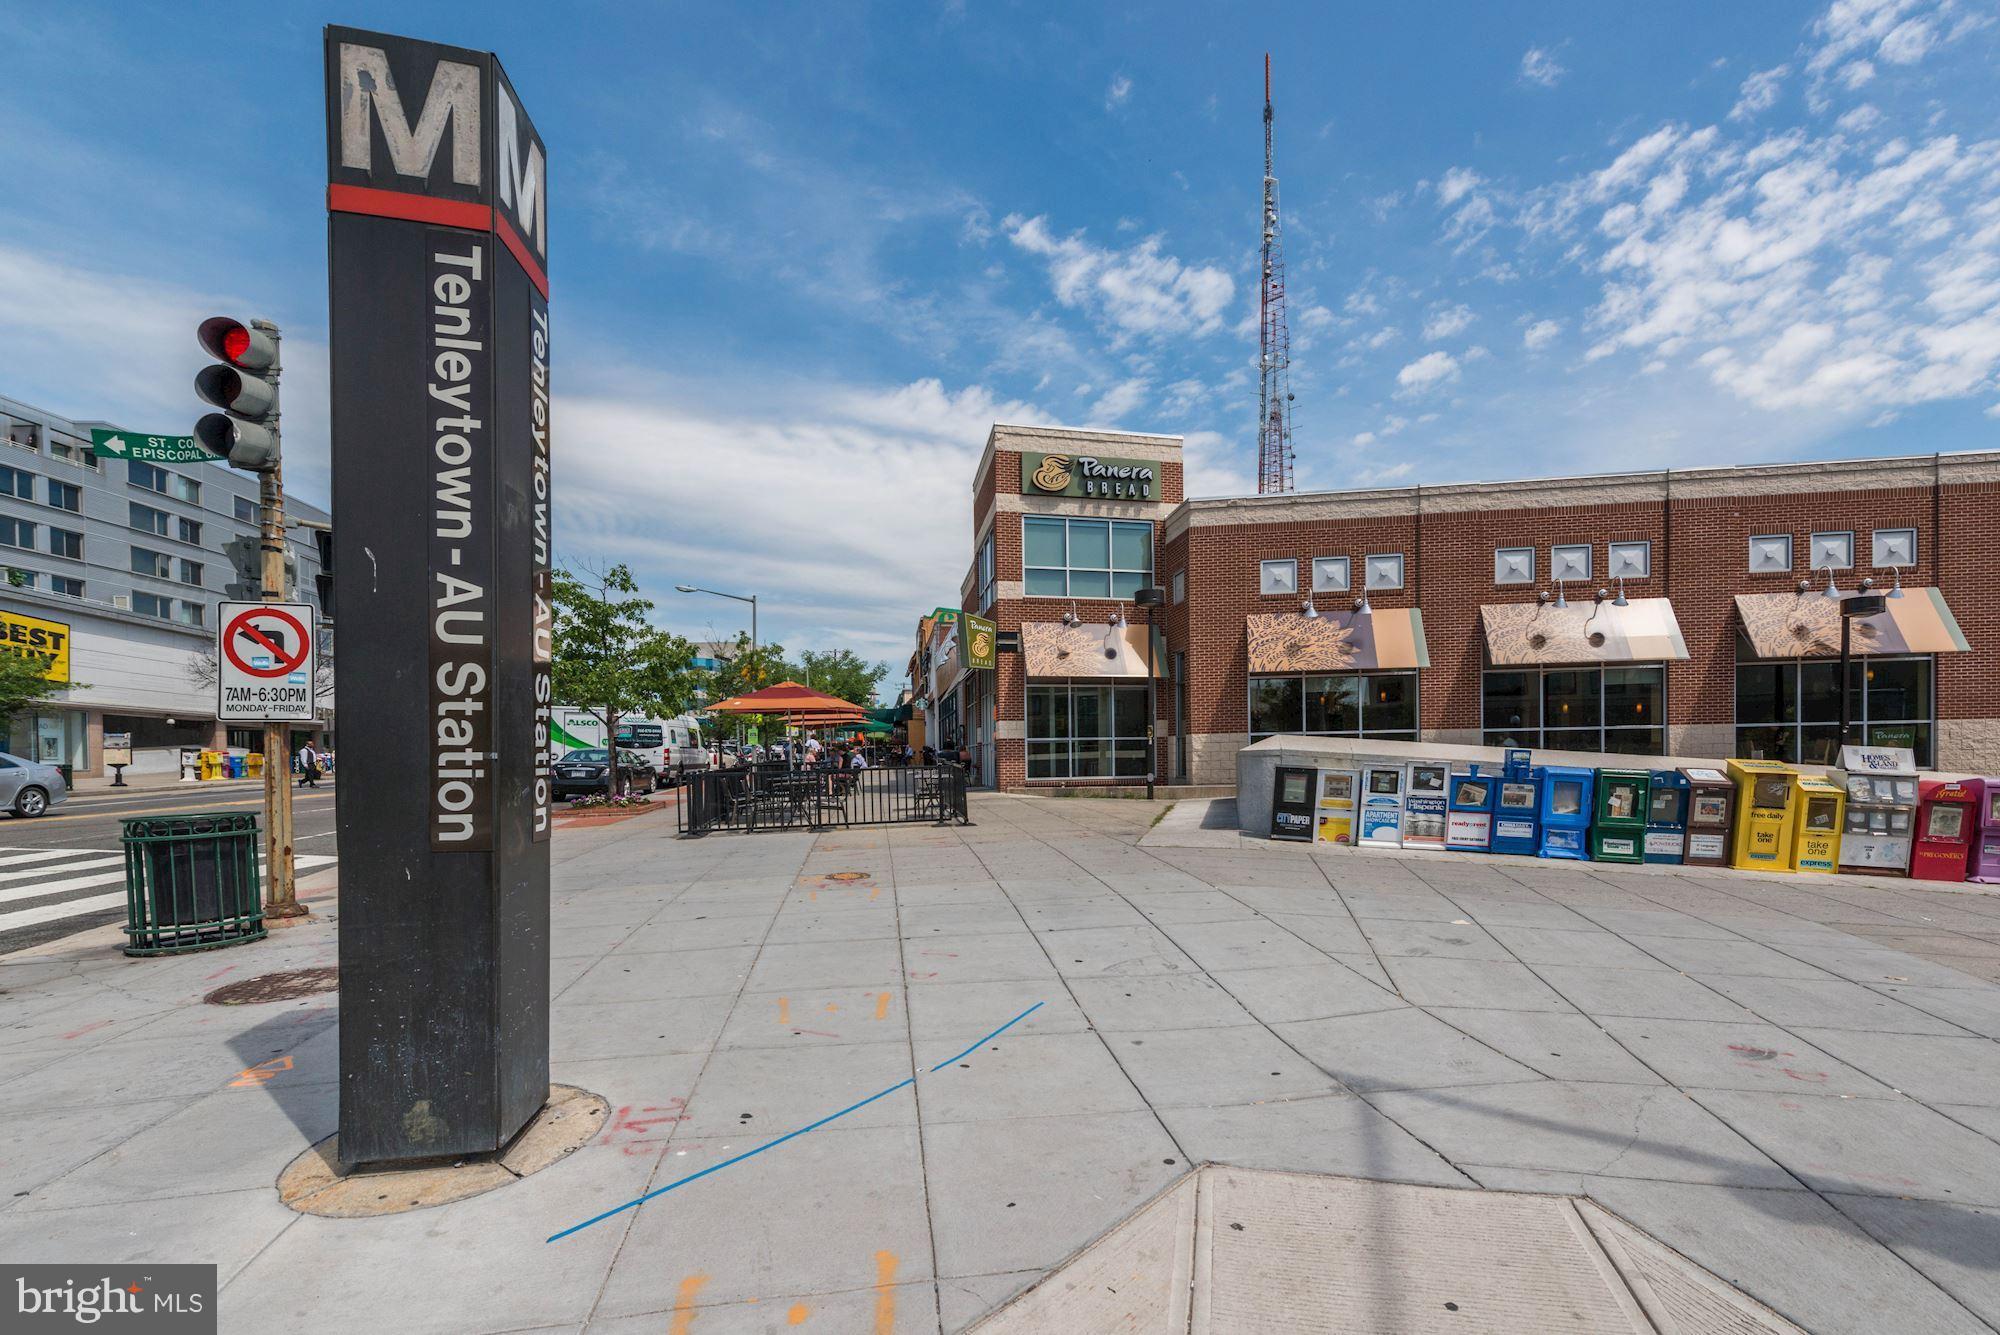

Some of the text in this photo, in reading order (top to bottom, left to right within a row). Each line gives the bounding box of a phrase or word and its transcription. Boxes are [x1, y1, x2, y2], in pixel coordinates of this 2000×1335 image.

[340, 42, 481, 187] M
[499, 81, 546, 261] M
[148, 437, 171, 448] ST.
[132, 447, 202, 460] EPISCOPAL
[1078, 457, 1153, 480] Panera
[1087, 481, 1151, 498] BREAD
[970, 619, 993, 633] Panera
[225, 687, 306, 702] 7AM-6:30PM
[226, 704, 306, 712] MONDAY-FRIDAY
[566, 719, 598, 727] ALSCO
[1874, 731, 1910, 741] Panera
[436, 661, 487, 842] Station
[534, 672, 551, 832] Station
[1861, 754, 1891, 763] HOMES
[1408, 803, 1444, 811] Hispanic
[1366, 810, 1399, 819] APARTMENT
[1807, 841, 1829, 849] take
[1807, 848, 1827, 856] one
[1800, 860, 1833, 869] express
